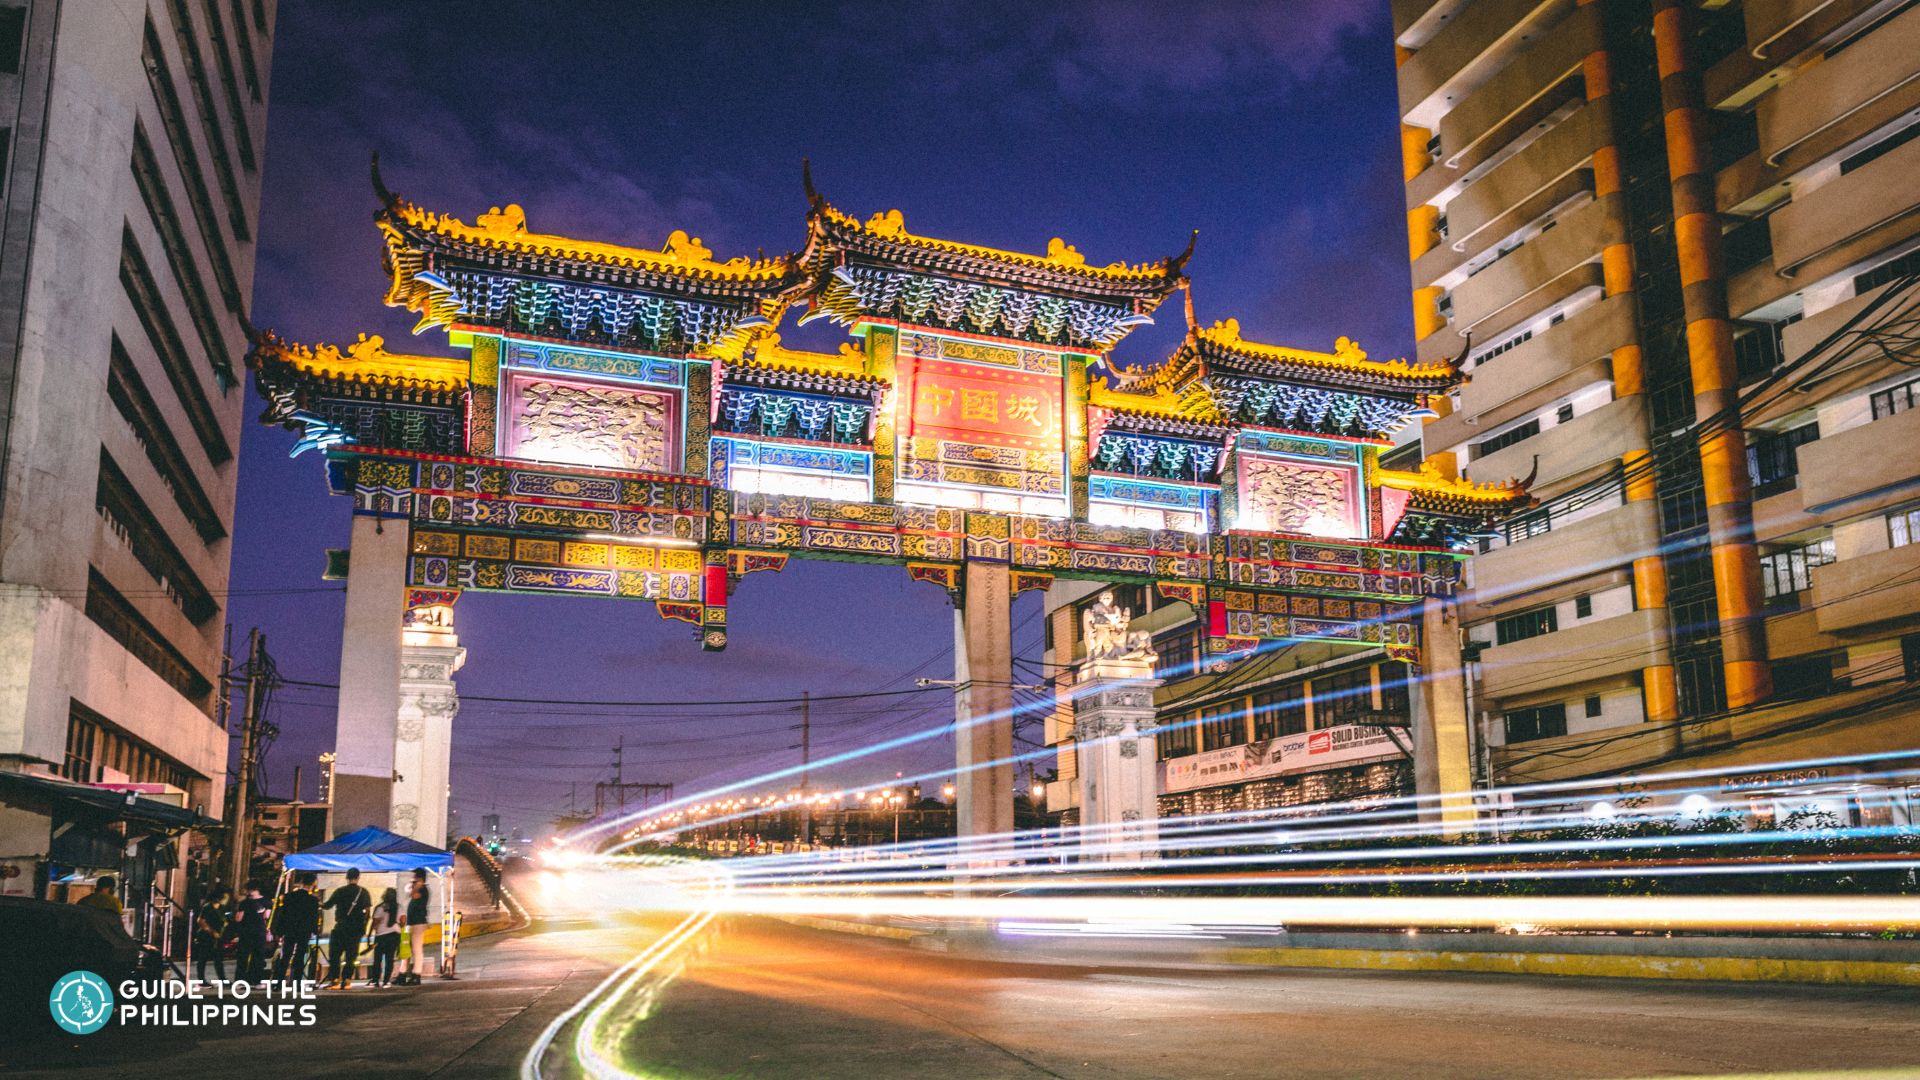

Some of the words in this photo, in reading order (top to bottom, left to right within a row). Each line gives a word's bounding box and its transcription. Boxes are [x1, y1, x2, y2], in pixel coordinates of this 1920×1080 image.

[916, 383, 1042, 427] 中國城
[1332, 728, 1352, 744] SOLID
[1354, 726, 1387, 740] BUSINE
